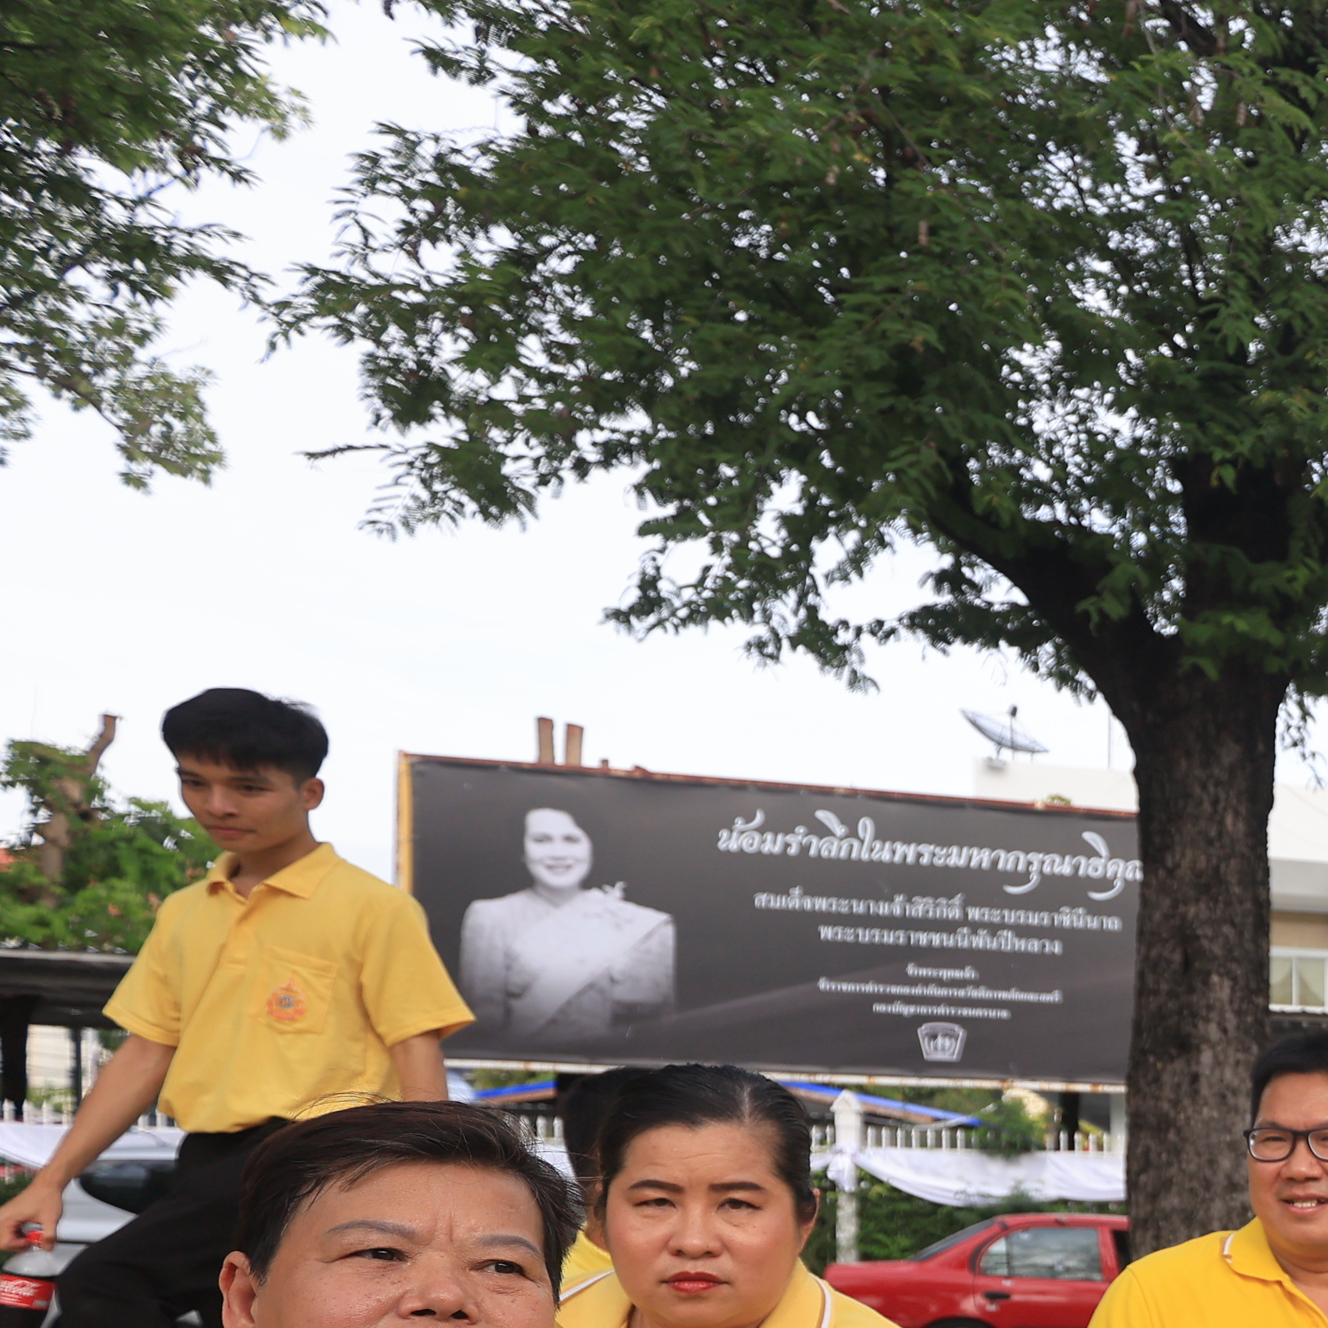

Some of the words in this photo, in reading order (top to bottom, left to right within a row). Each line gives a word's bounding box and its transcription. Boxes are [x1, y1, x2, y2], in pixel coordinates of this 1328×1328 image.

[818, 924, 1063, 956] พระบรมราชชนนีพันปีหลวง
